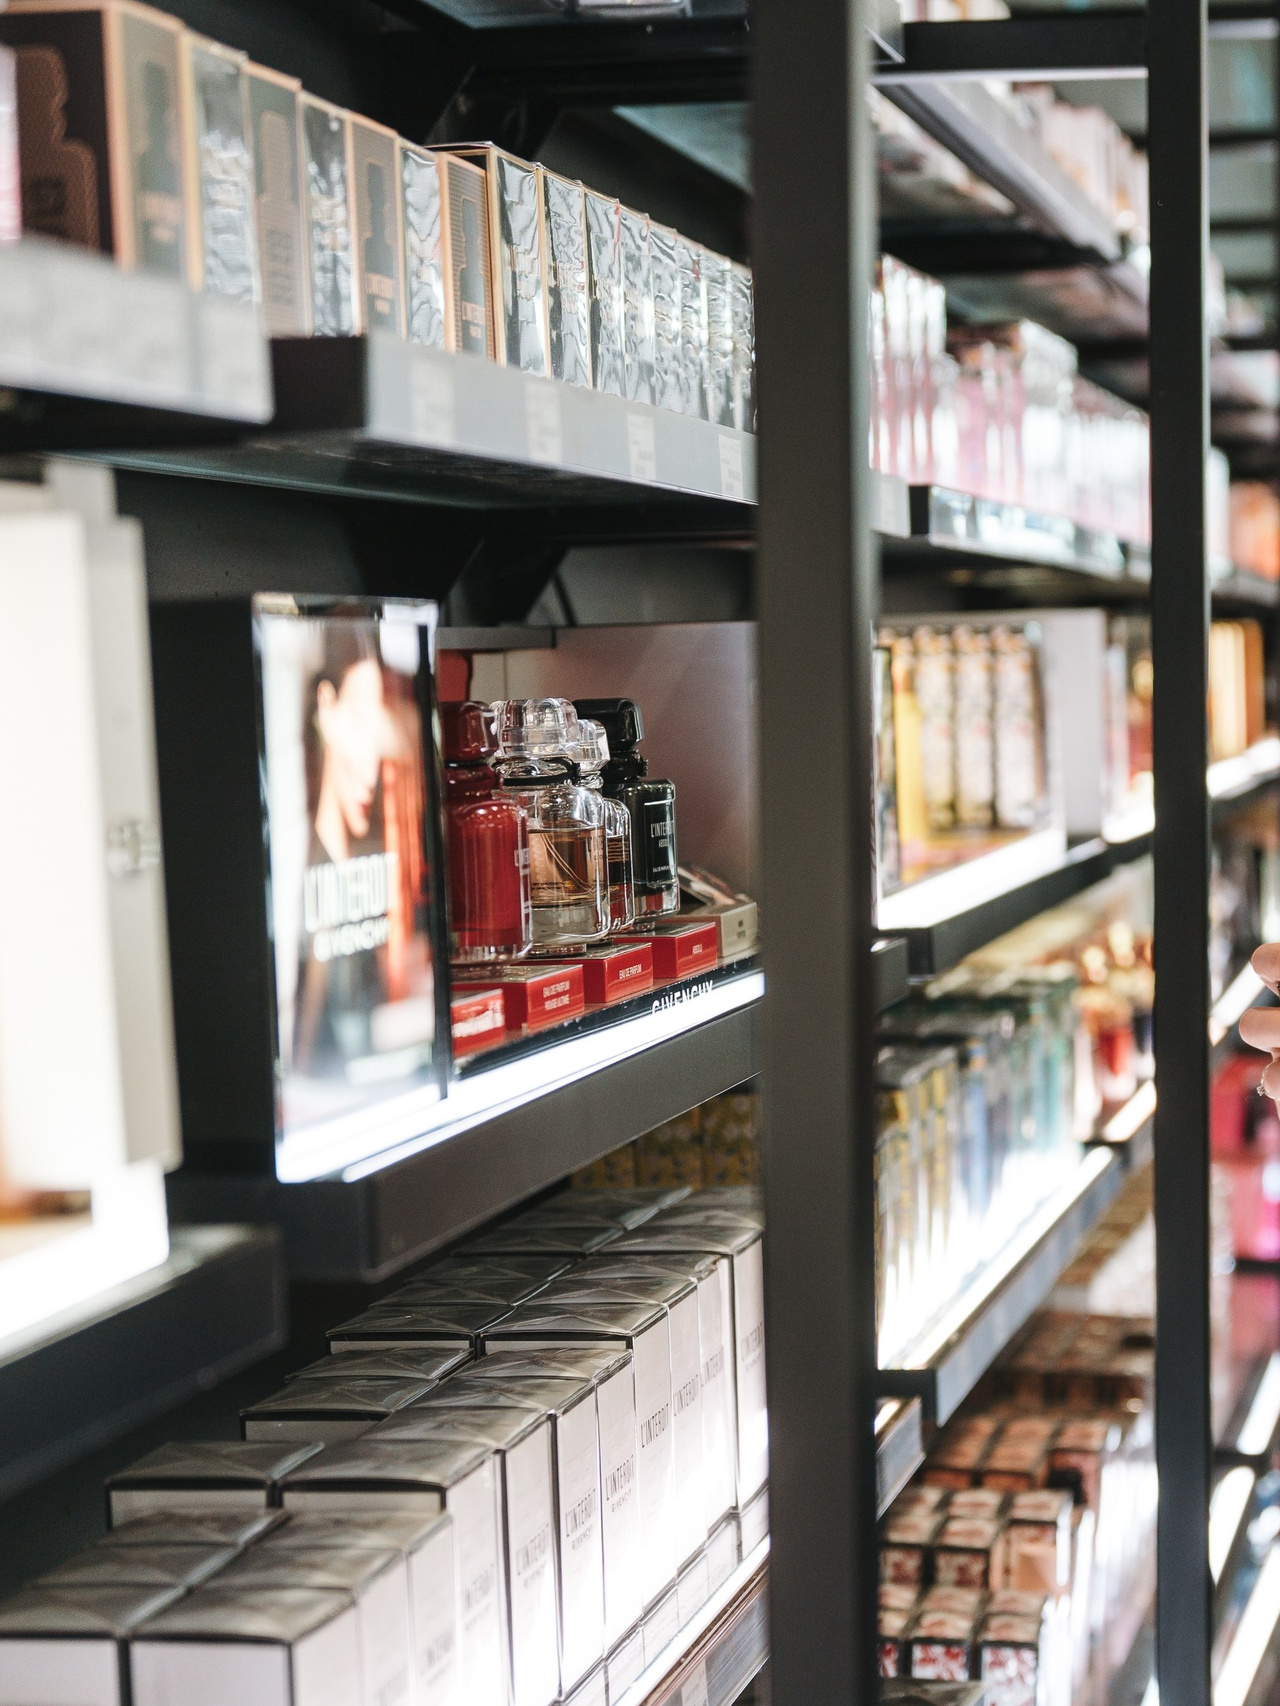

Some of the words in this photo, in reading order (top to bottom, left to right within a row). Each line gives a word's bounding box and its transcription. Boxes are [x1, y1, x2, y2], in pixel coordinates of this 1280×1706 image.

[652, 979, 714, 1016] GIVENCHY
[640, 1402, 670, 1449] L'INTERDIT
[605, 1453, 634, 1501] L'INTERDIT
[565, 1487, 597, 1538] L'INTERDIT
